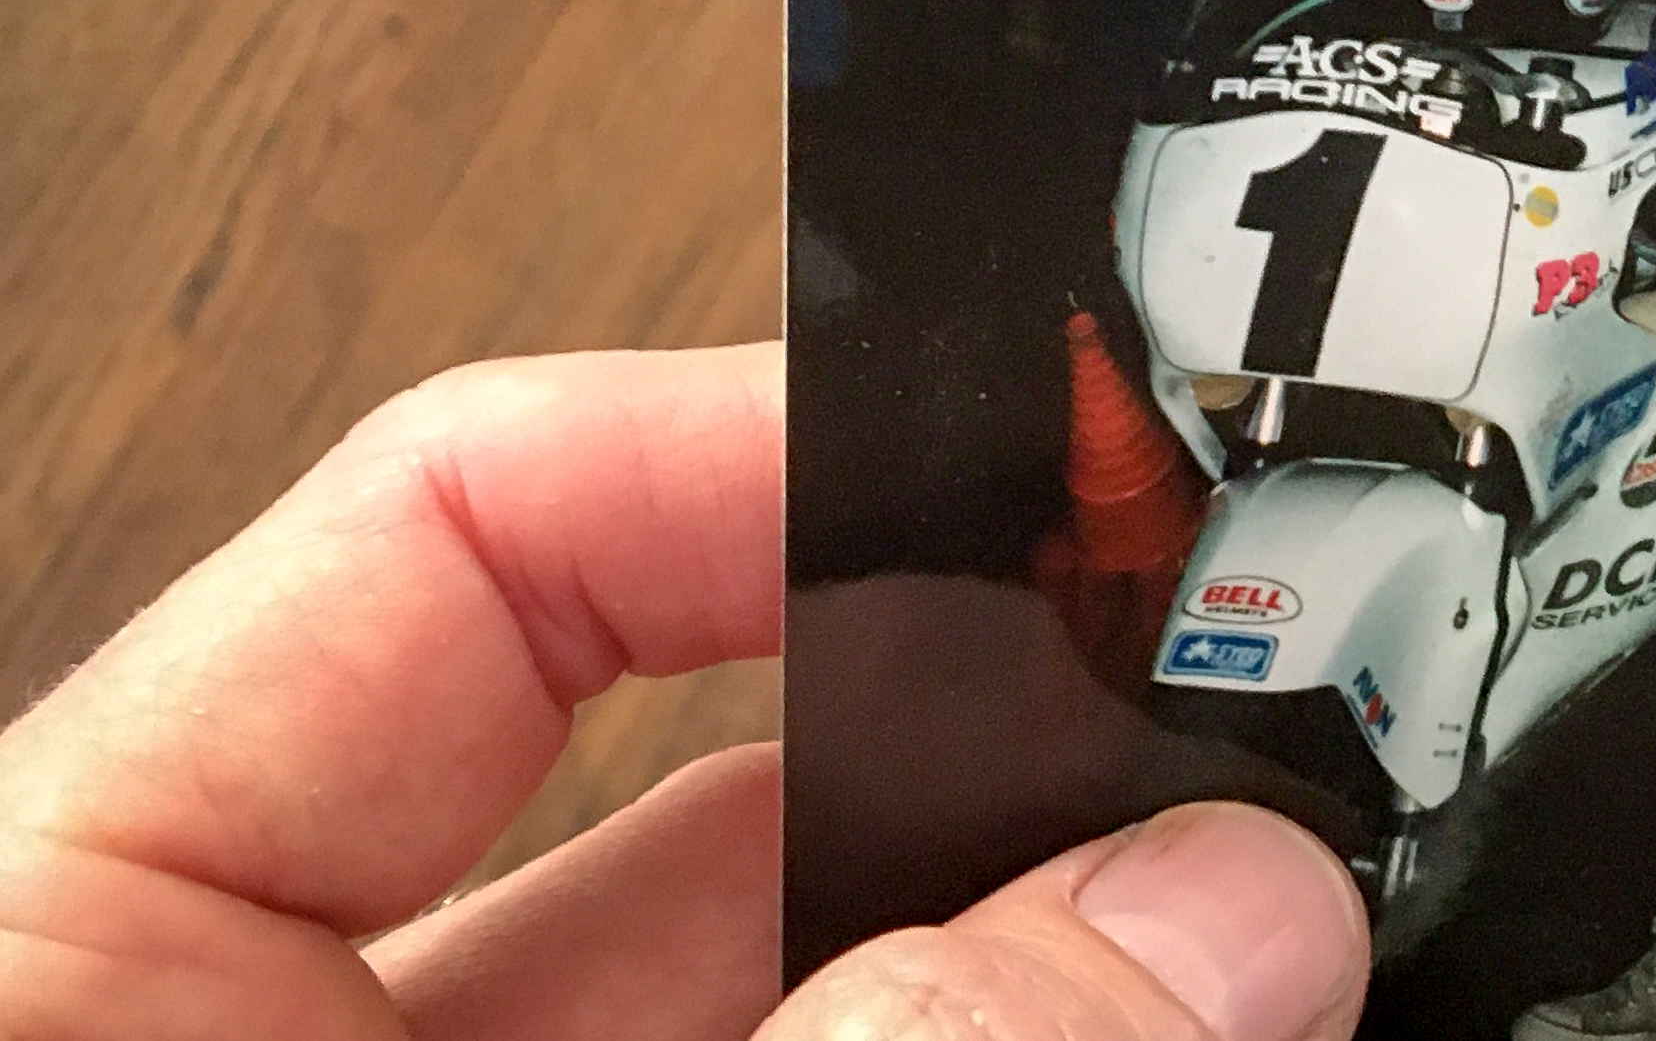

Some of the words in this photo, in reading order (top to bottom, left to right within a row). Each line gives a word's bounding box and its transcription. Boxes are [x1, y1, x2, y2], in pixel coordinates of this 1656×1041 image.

[1211, 77, 1463, 139] RACING
[1236, 128, 1388, 378] 1
[1202, 585, 1282, 610] BELL
